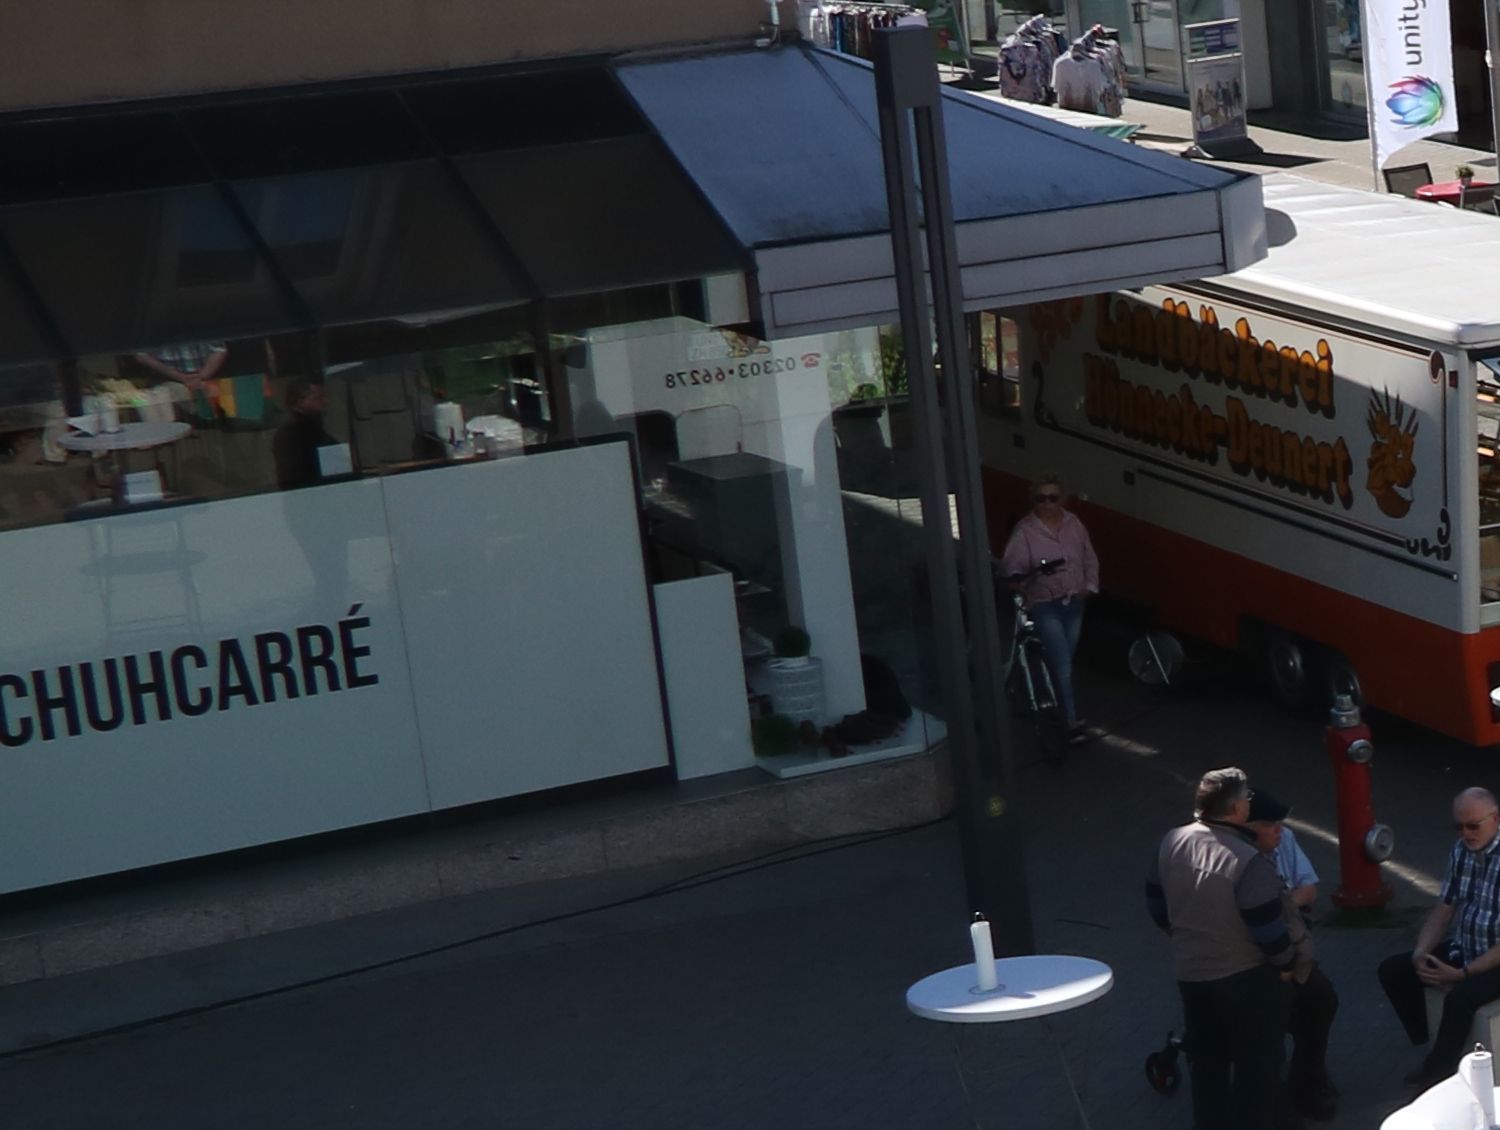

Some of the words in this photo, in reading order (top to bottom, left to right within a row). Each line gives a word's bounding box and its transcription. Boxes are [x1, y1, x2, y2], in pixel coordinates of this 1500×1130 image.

[1096, 291, 1335, 419] Landbäckerei
[1084, 352, 1354, 510] Hönnecke-Deunert
[0, 603, 379, 747] CHUHCARRÉ
